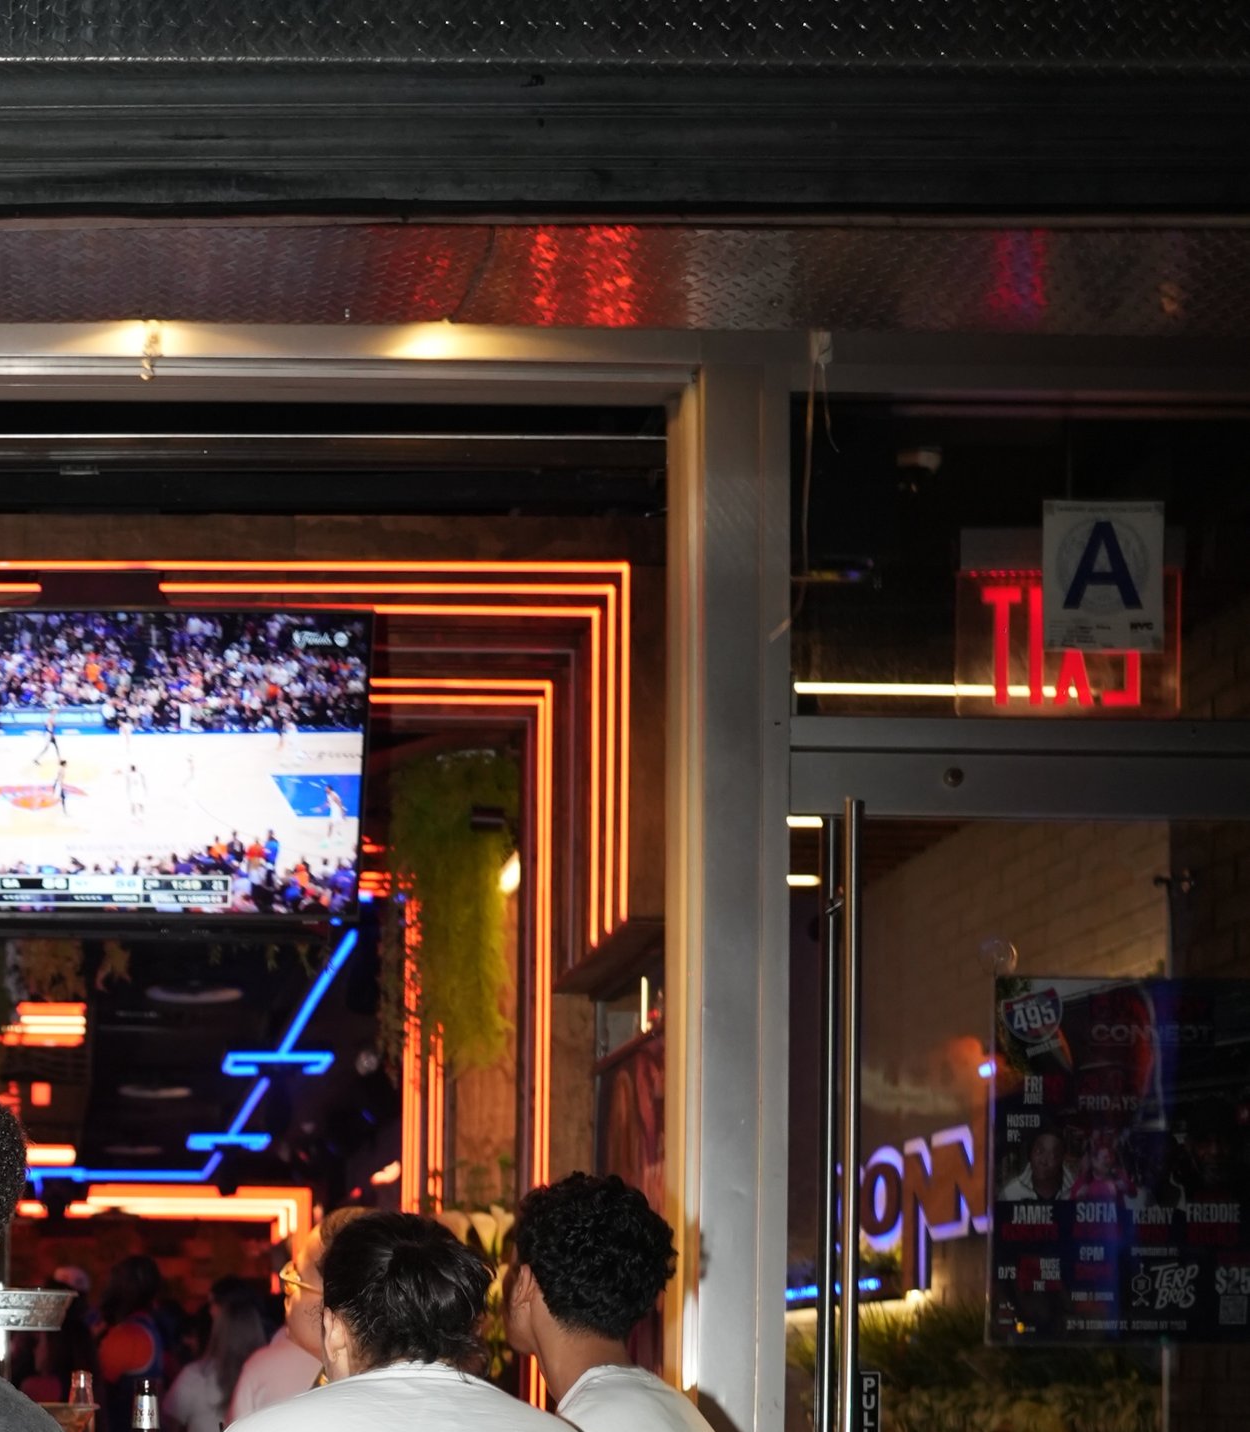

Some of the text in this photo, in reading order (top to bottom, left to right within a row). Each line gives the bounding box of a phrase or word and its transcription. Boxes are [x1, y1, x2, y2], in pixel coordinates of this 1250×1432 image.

[1063, 521, 1142, 609] A
[1014, 1001, 1057, 1032] 495
[1024, 1075, 1043, 1092] FRI
[1078, 1096, 1139, 1111] FRIDAYS
[1006, 1114, 1040, 1127] HOSTED
[1011, 1205, 1053, 1224] JAMIE
[1075, 1202, 1117, 1223] SOFIA
[1132, 1207, 1174, 1225] KENNY
[1186, 1202, 1241, 1223] FREDDIE
[1149, 1262, 1200, 1288] TERP
[1154, 1285, 1196, 1310] BROS
